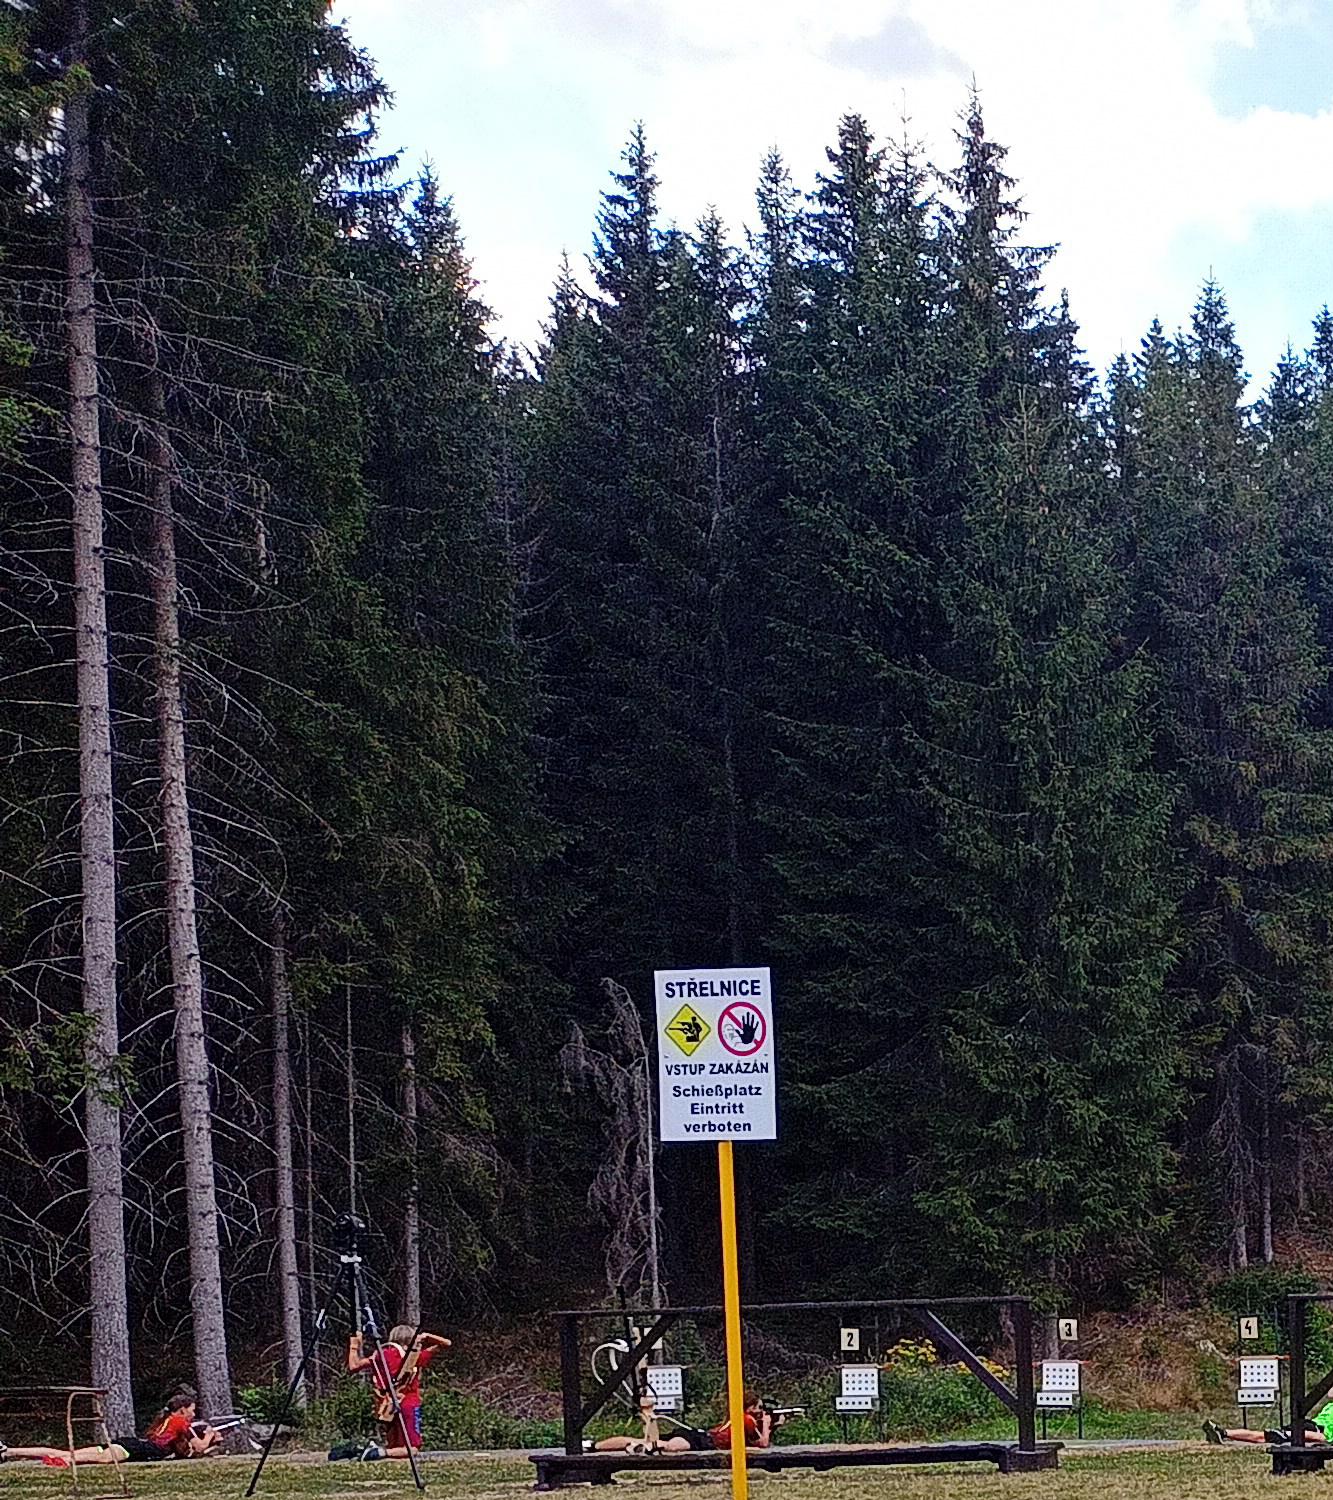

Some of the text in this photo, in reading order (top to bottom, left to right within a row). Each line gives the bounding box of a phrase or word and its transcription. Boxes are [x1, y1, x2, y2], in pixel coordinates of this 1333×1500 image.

[665, 978, 761, 998] STŘELNICE
[665, 1059, 769, 1076] VSTUP ZAKÁZÁN
[672, 1084, 763, 1099] Schießplatz
[690, 1102, 744, 1115] Eintritt
[684, 1120, 752, 1133] verboten
[1064, 1322, 1072, 1336] 3
[1245, 1320, 1252, 1335] 4
[847, 1332, 854, 1347] 2
